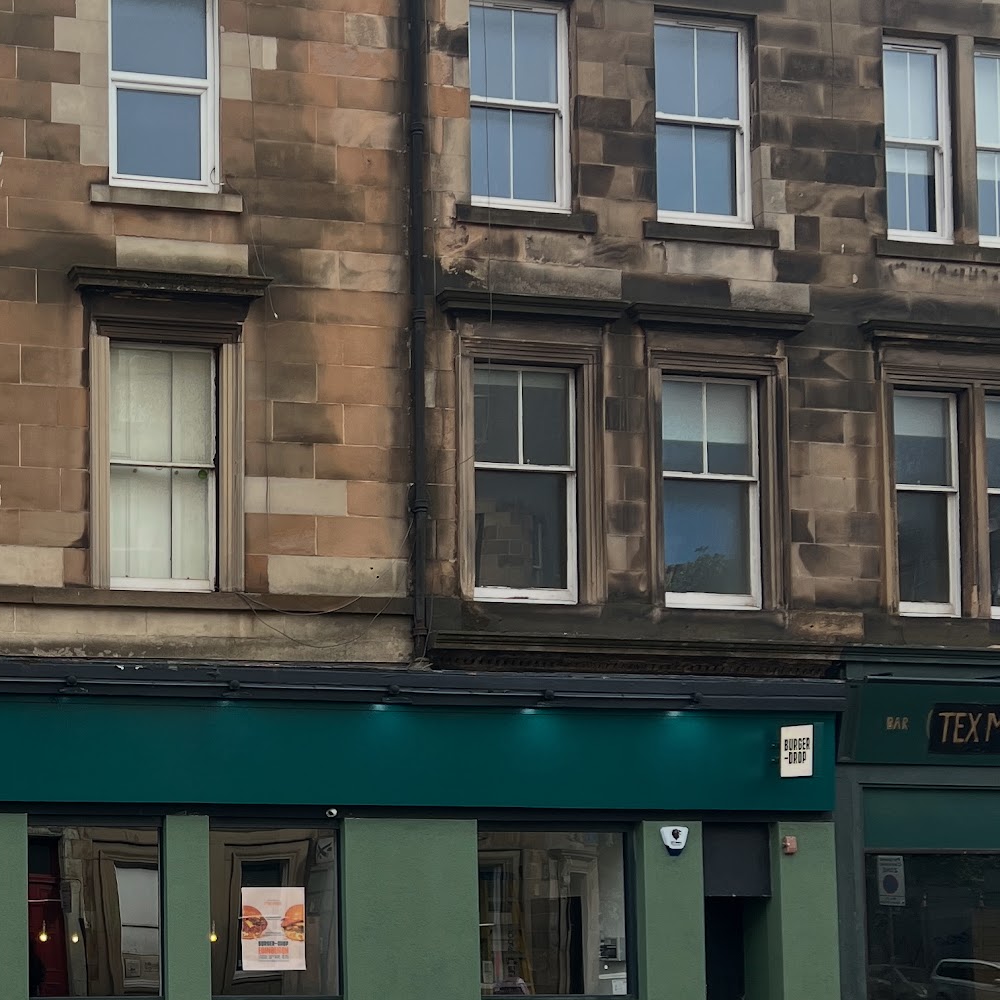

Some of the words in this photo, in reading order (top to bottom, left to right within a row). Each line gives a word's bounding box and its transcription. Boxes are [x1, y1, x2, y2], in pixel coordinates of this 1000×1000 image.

[886, 716, 909, 730] BAR
[938, 712, 983, 743] TEX
[784, 737, 810, 751] BURGER
